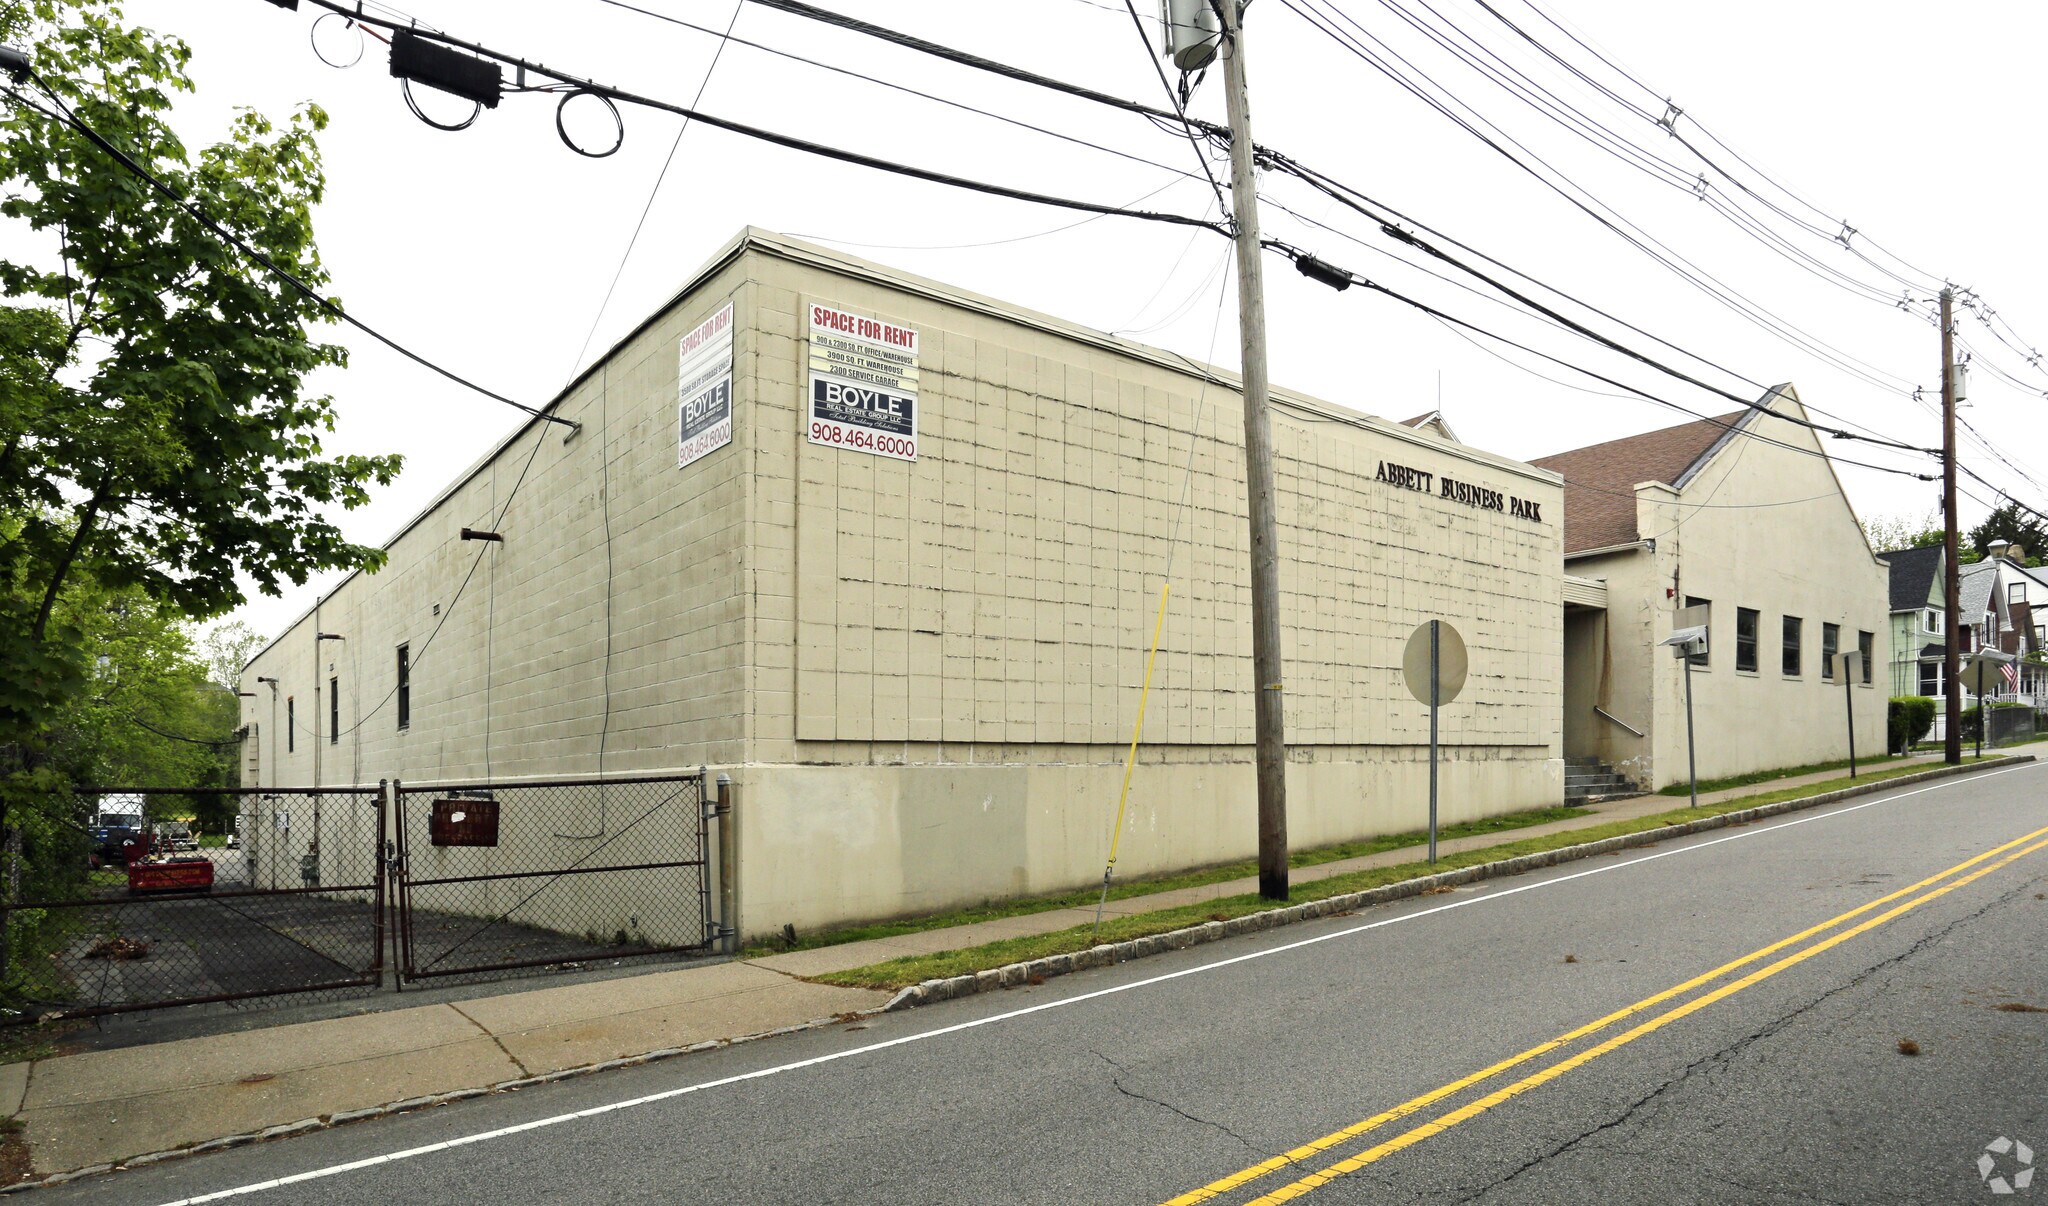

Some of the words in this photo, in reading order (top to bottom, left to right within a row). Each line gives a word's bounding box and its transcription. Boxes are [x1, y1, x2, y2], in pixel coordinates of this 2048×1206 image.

[681, 332, 701, 357] SPACE
[702, 321, 714, 343] FOR
[715, 306, 731, 332] RENT
[814, 307, 854, 333] SPACE
[858, 318, 880, 340] FOR
[884, 326, 914, 348] RENT
[816, 336, 827, 344] 900
[833, 340, 847, 349] 2300
[827, 351, 844, 361] 3900
[846, 355, 856, 364] SQ.
[866, 360, 904, 375] WAREHOUSE
[829, 365, 847, 375] 2300
[848, 369, 874, 381] SERVICE
[875, 375, 899, 387] GARAGE
[686, 383, 724, 423] BOYLE
[826, 383, 902, 416] BOYLE
[826, 404, 842, 412] REAL
[845, 407, 866, 416] ESTATE
[868, 411, 888, 420] GROUP
[848, 416, 873, 427] Building
[679, 422, 730, 465] 908.464.6000
[812, 422, 914, 457] 908.464.6000
[1376, 460, 1433, 492] ABBETT
[1441, 477, 1503, 512] BUSINESS
[1510, 496, 1542, 522] PARK
